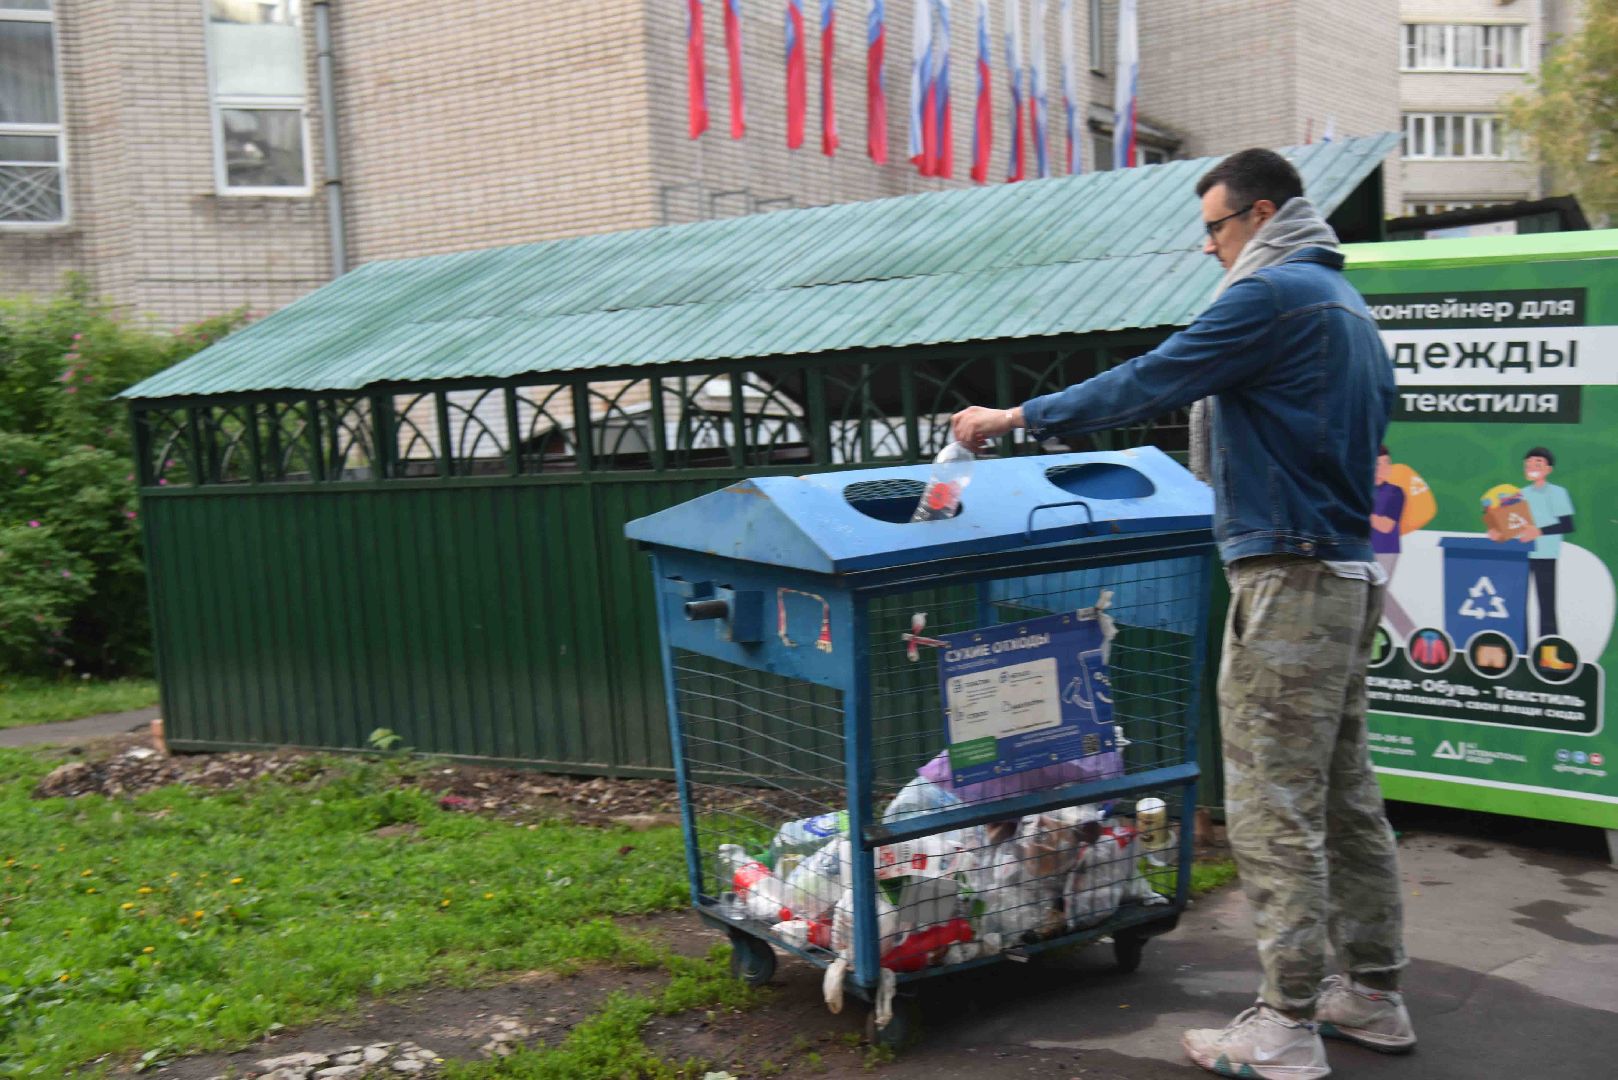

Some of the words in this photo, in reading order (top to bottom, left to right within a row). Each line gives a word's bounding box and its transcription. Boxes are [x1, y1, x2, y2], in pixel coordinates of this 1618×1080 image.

[1518, 299, 1575, 320] для
[1393, 340, 1578, 374] дежды
[1402, 393, 1559, 413] текстиля
[1365, 676, 1413, 690] ежда
